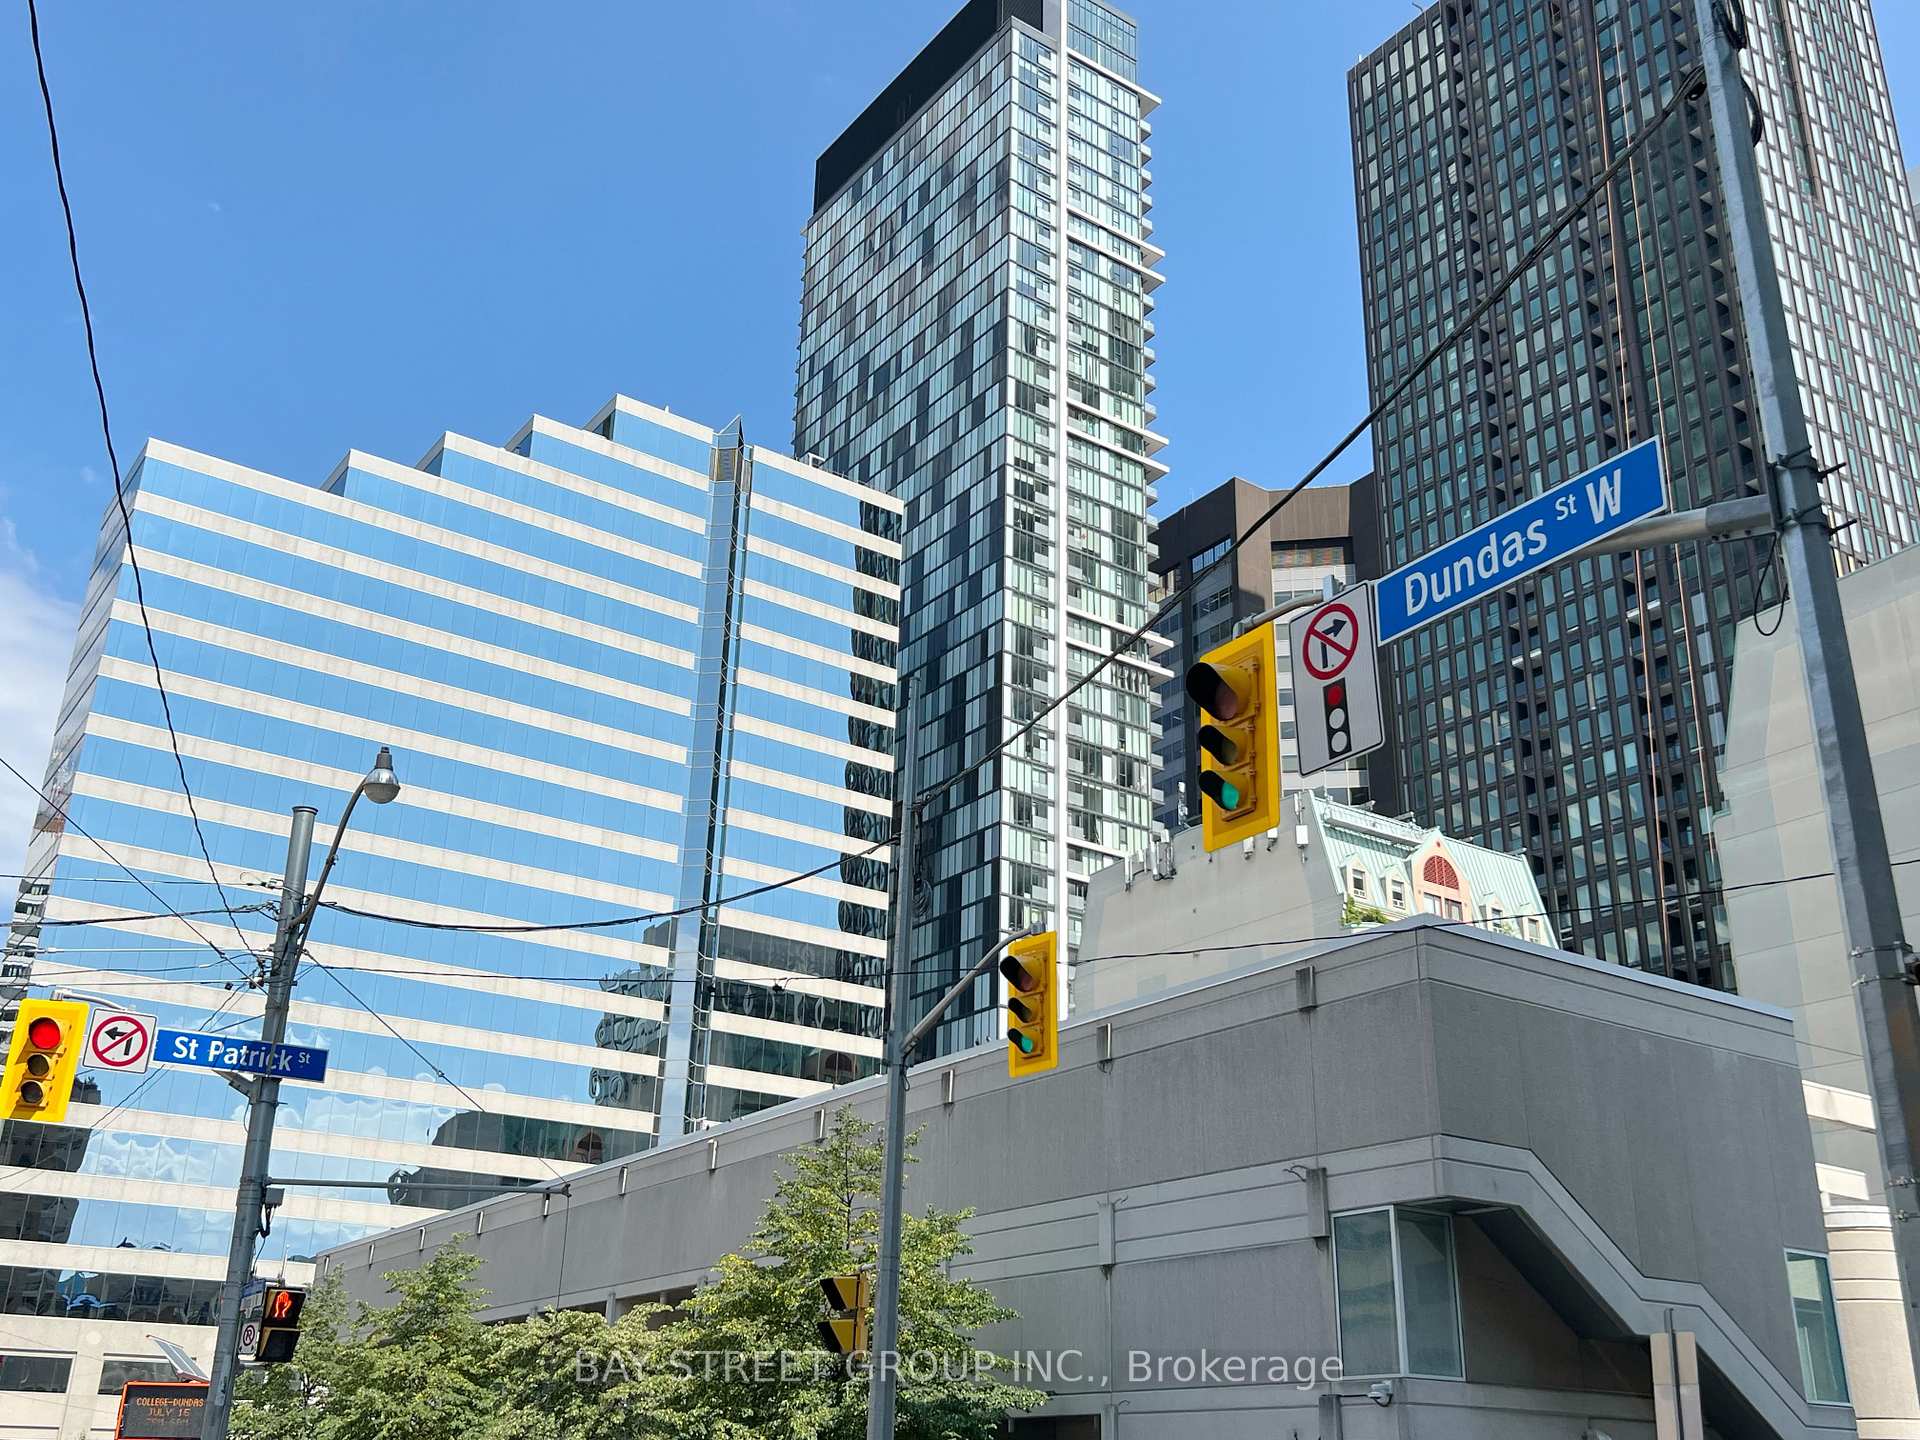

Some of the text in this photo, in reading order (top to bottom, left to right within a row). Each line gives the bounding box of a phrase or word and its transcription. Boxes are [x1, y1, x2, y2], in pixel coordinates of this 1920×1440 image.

[1404, 468, 1622, 617] Dundas St W
[172, 1036, 311, 1072] St Patrick St
[136, 1397, 204, 1407] COLLEGE-DUNDAS
[149, 1408, 173, 1418] JULY
